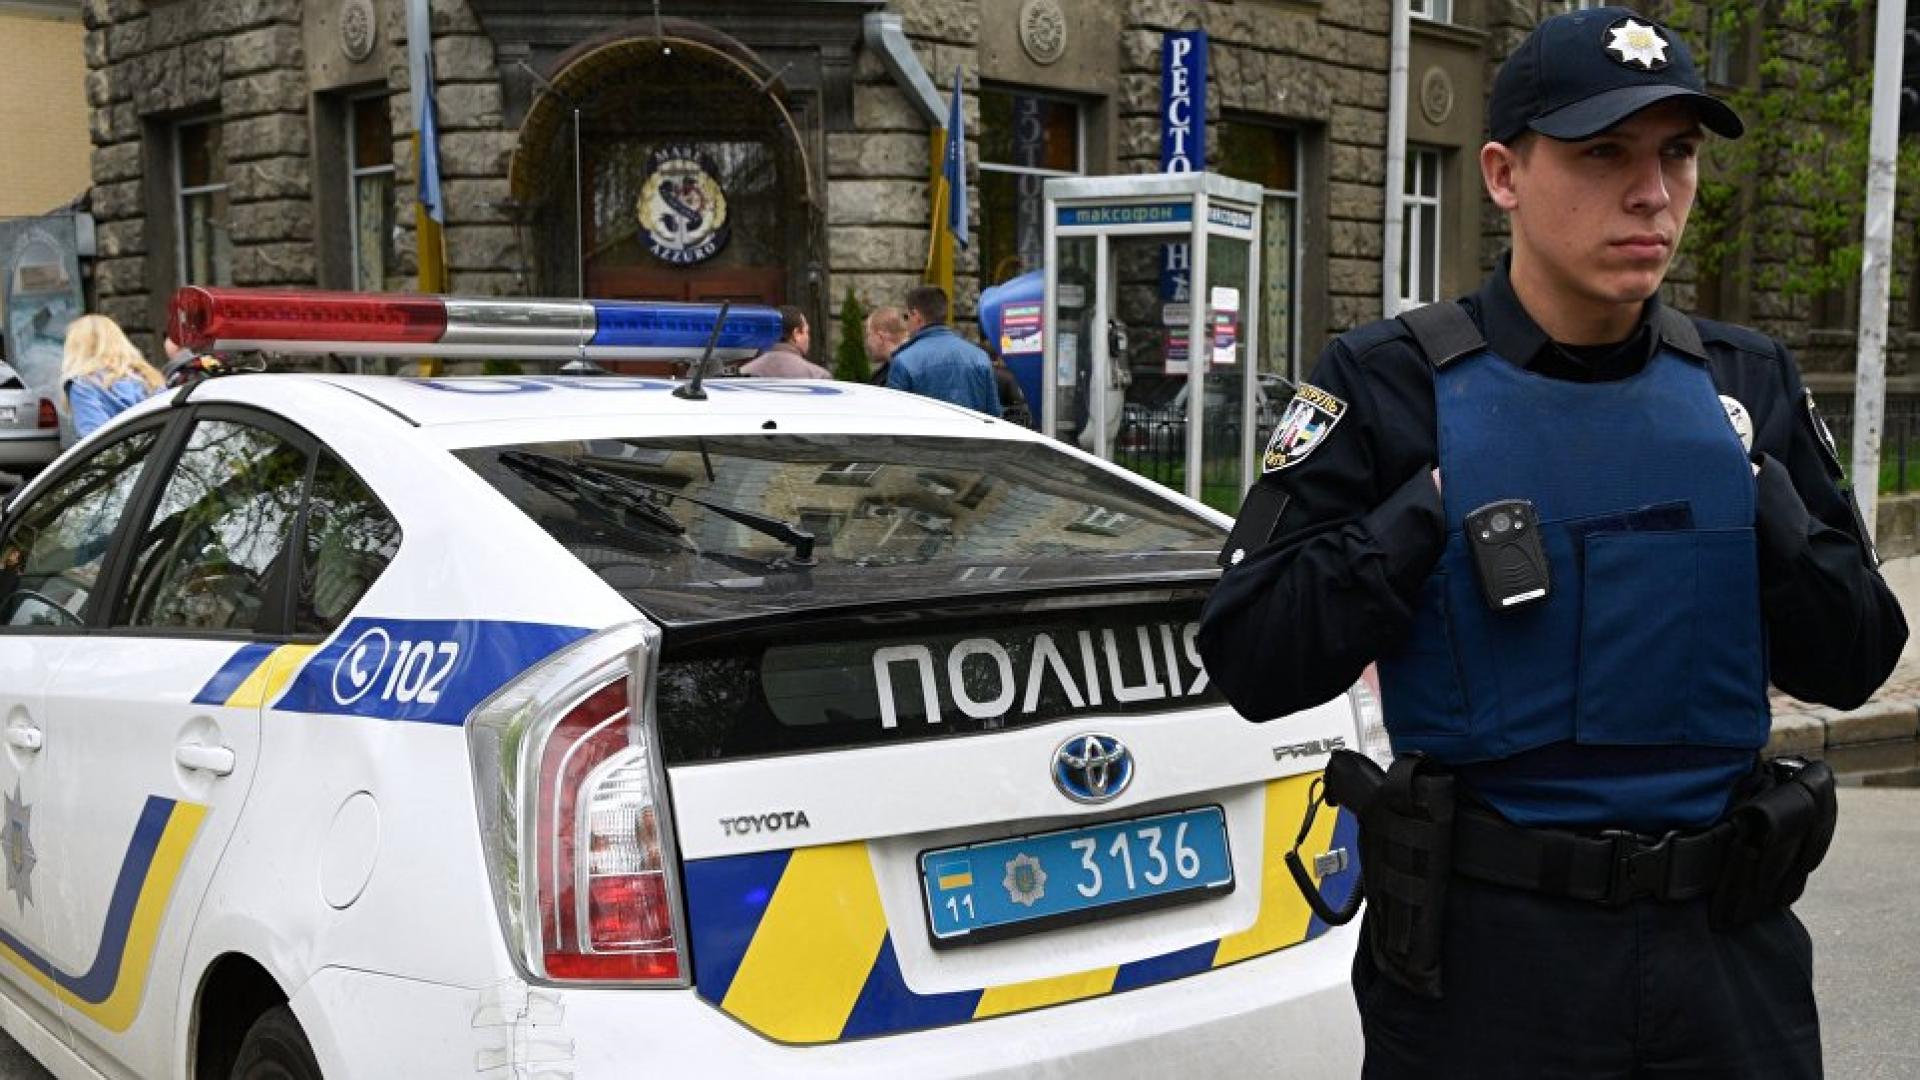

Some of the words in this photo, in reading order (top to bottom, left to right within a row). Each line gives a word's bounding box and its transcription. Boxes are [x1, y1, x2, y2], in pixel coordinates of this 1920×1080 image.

[381, 640, 459, 704] 102
[1273, 736, 1346, 761] PRIUS
[719, 809, 810, 836] TOYOTA
[1070, 820, 1201, 898] 3136
[945, 893, 976, 921] 11
